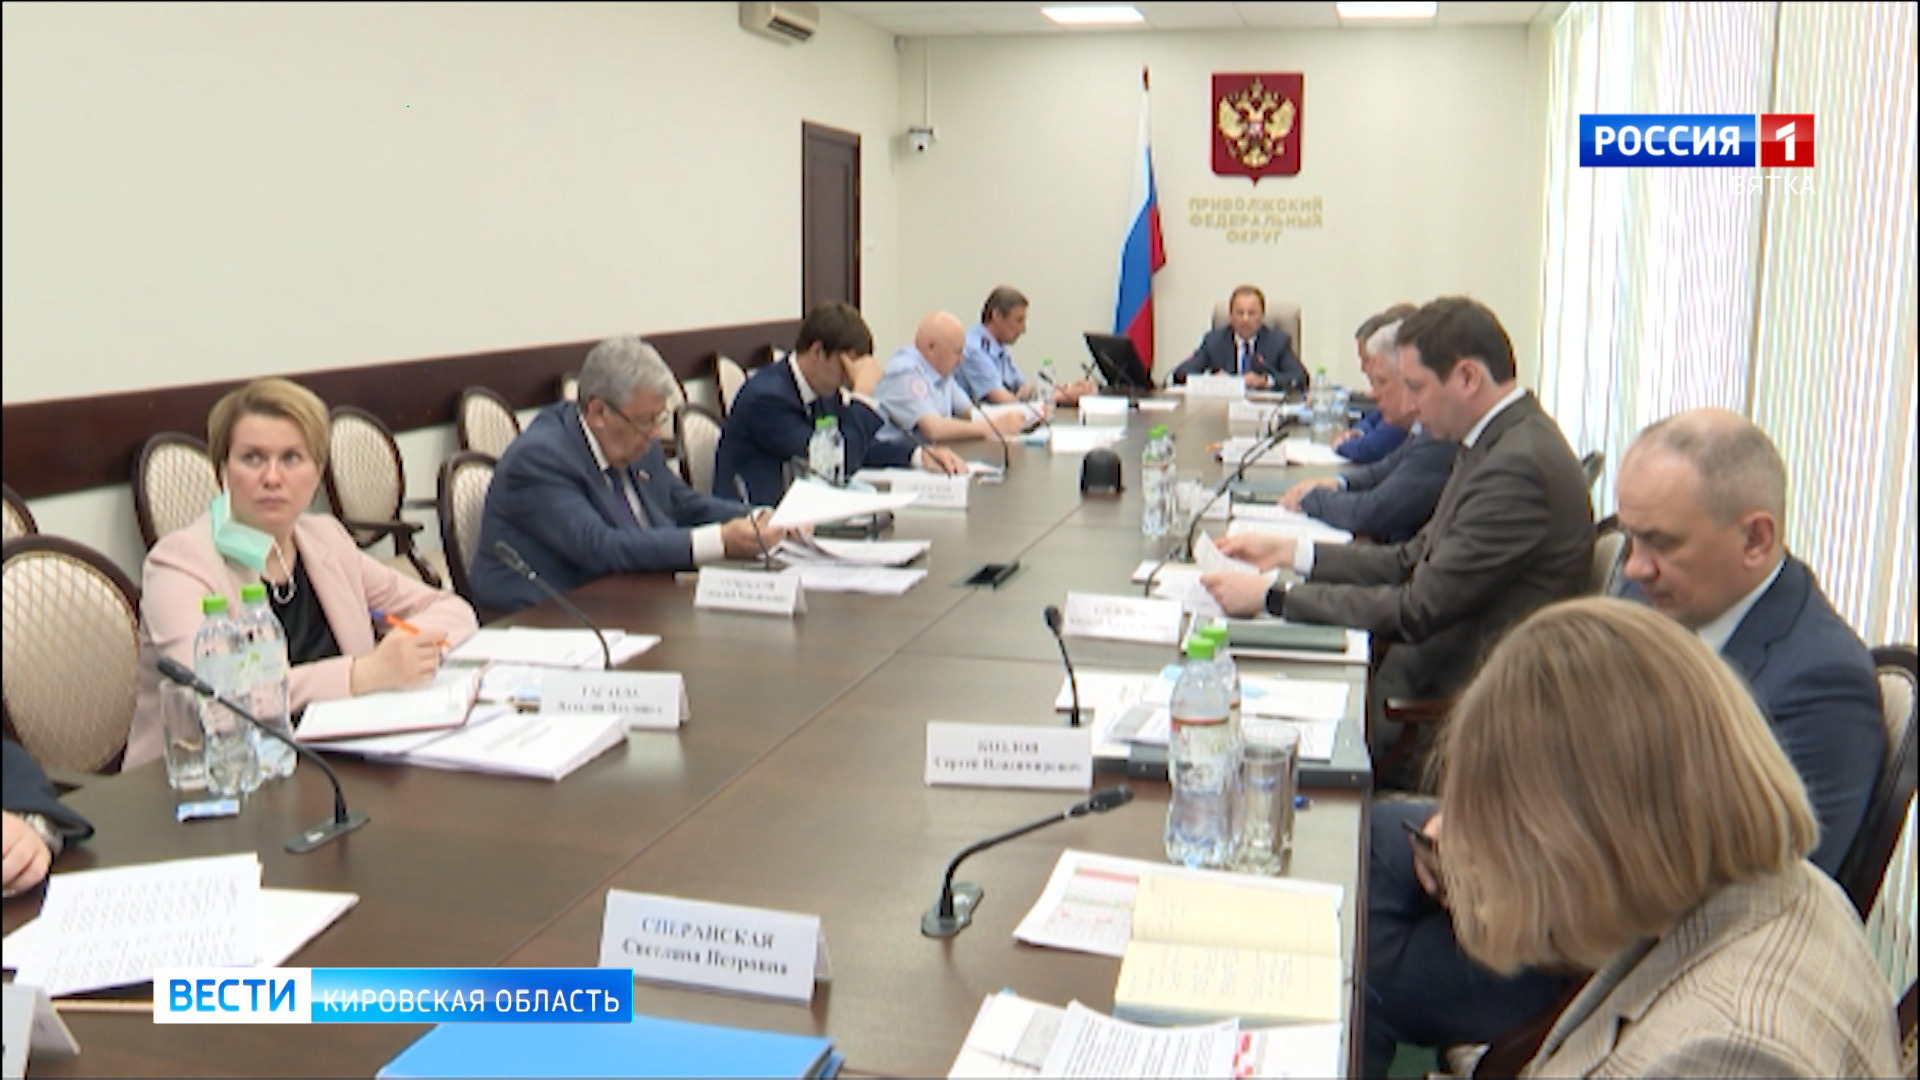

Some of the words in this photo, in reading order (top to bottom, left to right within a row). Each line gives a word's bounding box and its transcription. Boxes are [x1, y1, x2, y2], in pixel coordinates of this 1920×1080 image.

[1188, 195, 1323, 212] ПРИВОЛЖСКИЙ
[1188, 213, 1323, 229] ФЕДЕРАЛЬНЫЙ
[1226, 229, 1281, 244] ОКРУГ
[641, 916, 775, 949] СПЕРАНСКАЯ
[622, 937, 701, 964] Светлана
[706, 949, 788, 975] Петровна
